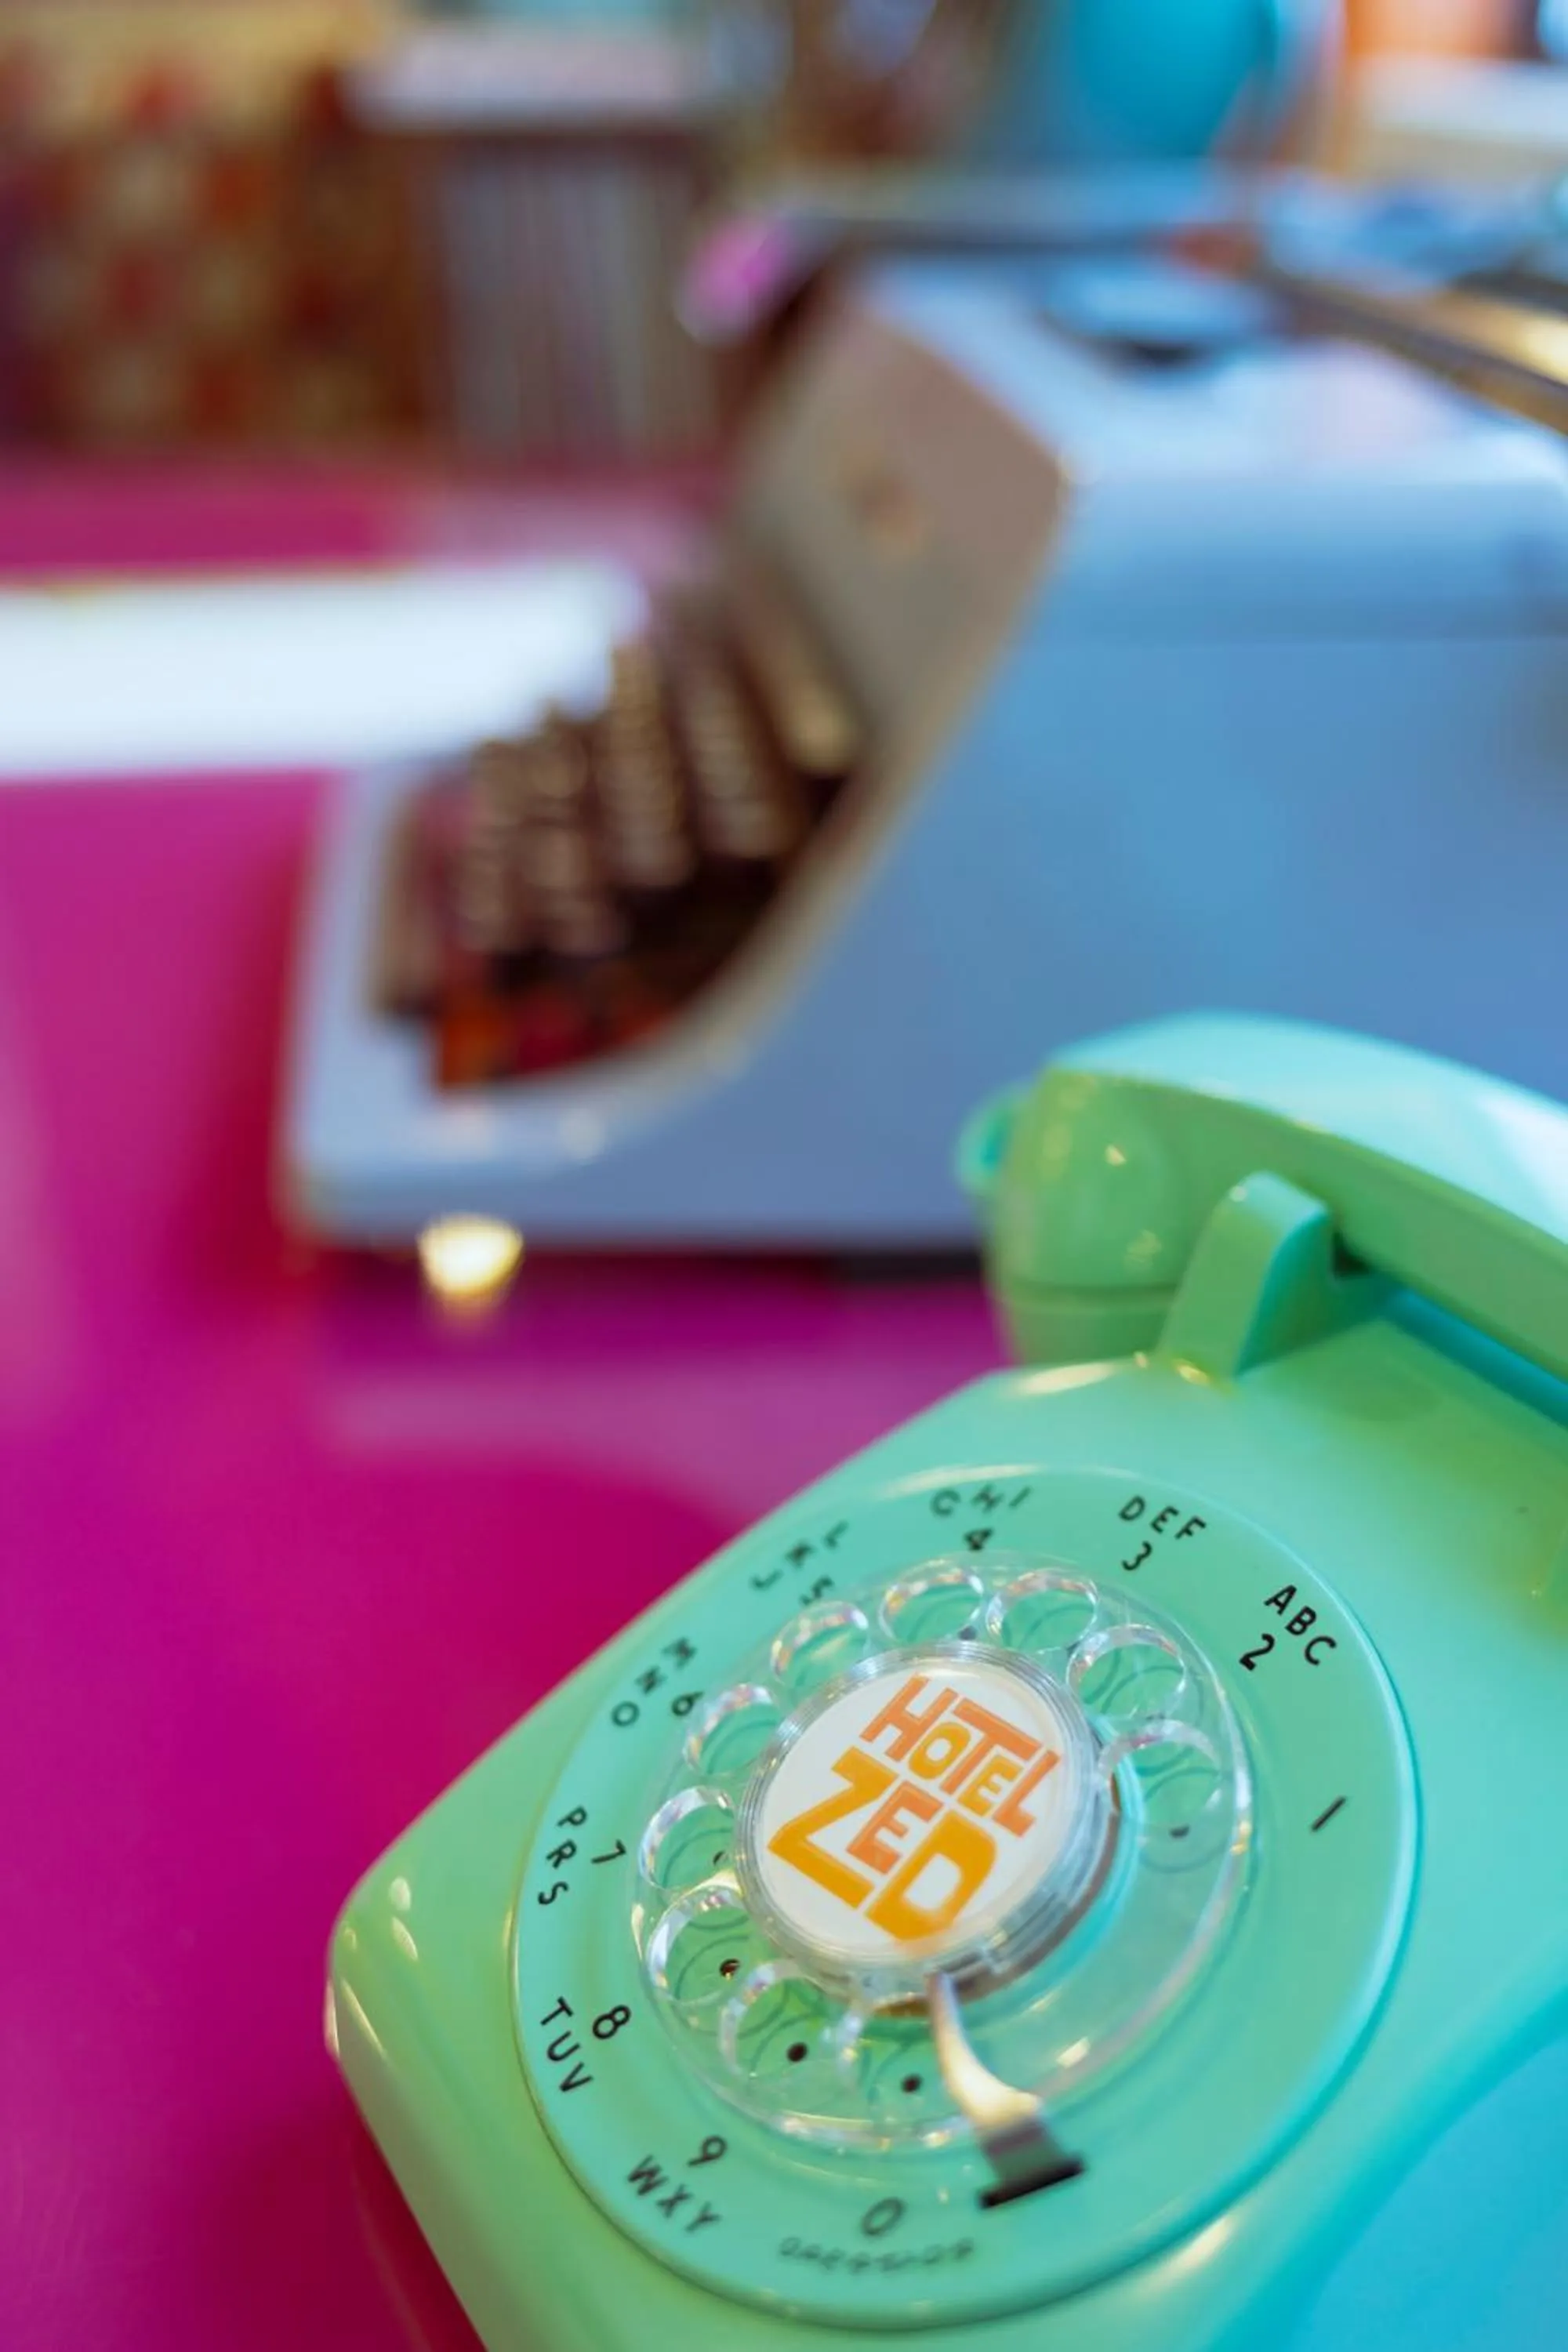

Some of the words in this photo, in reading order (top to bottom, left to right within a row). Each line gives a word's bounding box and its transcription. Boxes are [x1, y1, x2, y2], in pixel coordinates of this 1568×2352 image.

[1118, 1496, 1207, 1541] DEF
[1122, 1541, 1152, 1571] 3
[1263, 1584, 1338, 1666] ABC
[1239, 1633, 1276, 1671] 2
[671, 1691, 704, 1717] 6
[860, 1671, 1060, 1838] HOTEL
[538, 1806, 588, 1906] PRS
[591, 1838, 626, 1865] 7
[767, 1745, 996, 1941] ZED
[539, 1996, 593, 2094] TUV
[592, 2005, 632, 2040] 8
[688, 2135, 728, 2169] 9
[626, 2154, 723, 2234] WXY
